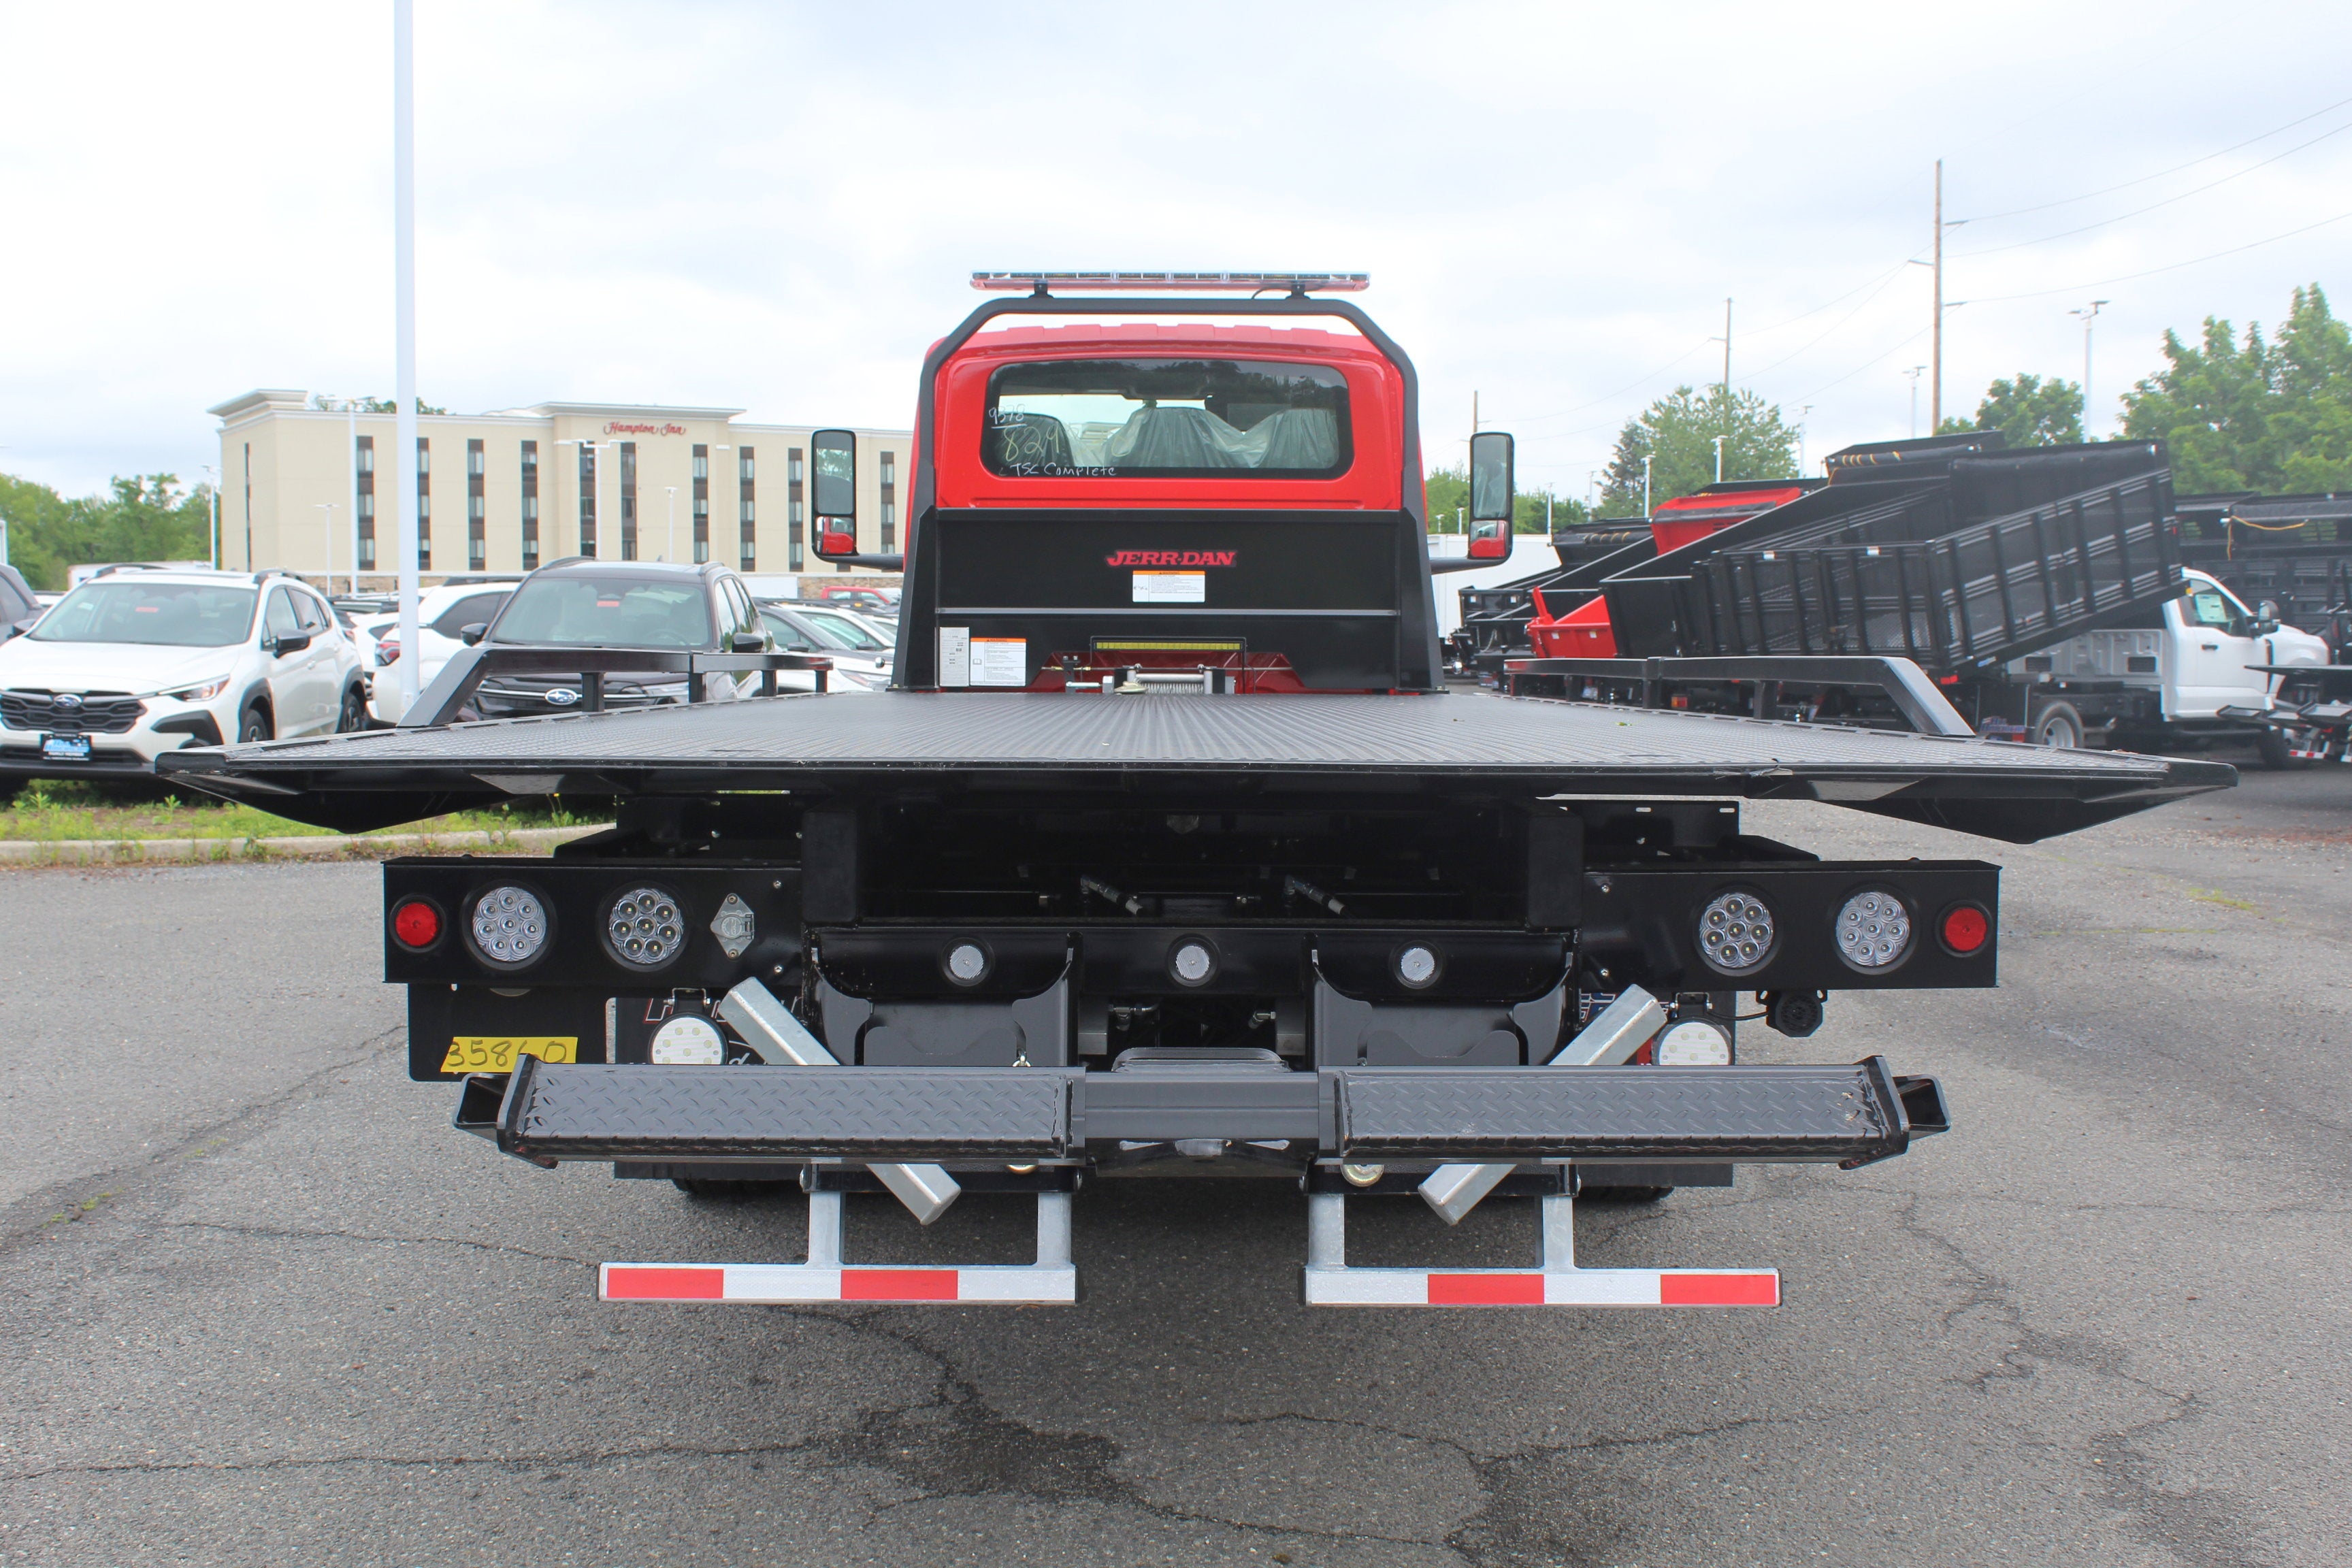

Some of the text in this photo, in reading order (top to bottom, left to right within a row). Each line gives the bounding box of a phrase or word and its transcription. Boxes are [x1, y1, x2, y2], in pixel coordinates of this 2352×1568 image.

[603, 421, 687, 436] Hampton Inn
[1106, 551, 1235, 566] JERR-DAN
[446, 1039, 567, 1067] 3580
